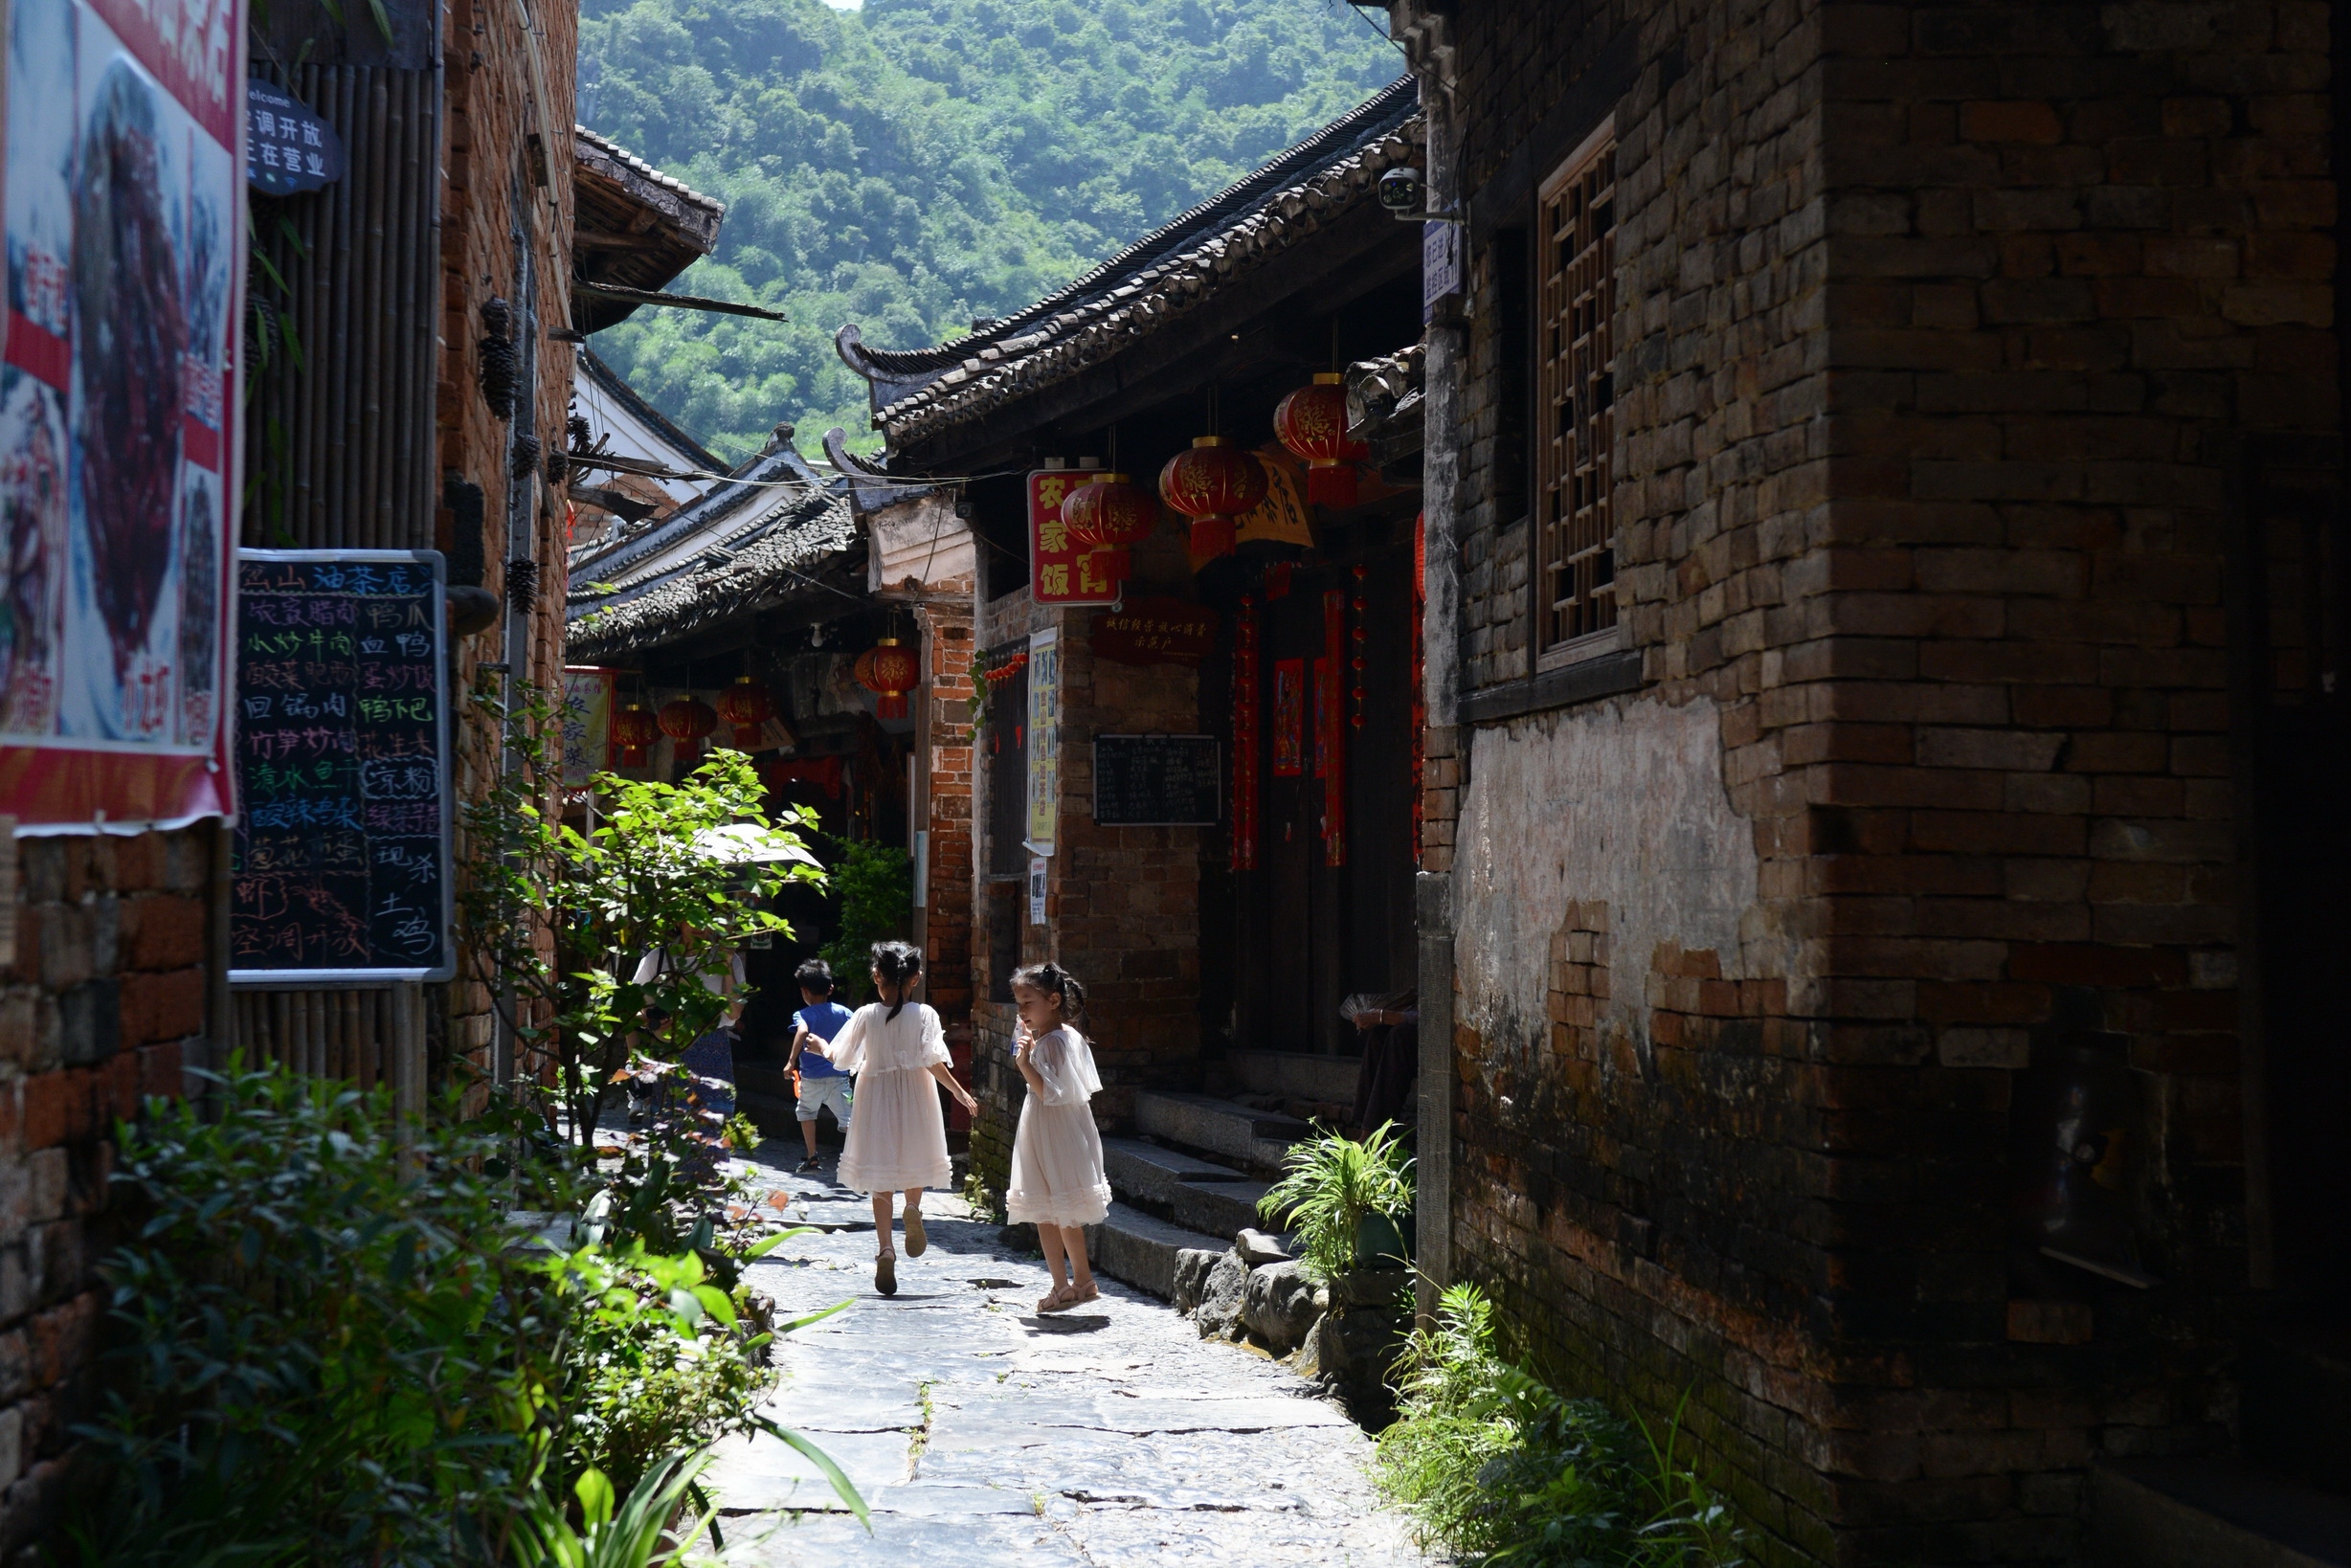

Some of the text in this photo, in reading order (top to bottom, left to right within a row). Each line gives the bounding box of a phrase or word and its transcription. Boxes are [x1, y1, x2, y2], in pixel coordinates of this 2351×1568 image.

[248, 89, 291, 108] elcome
[1039, 477, 1070, 595] 农家饭
[247, 628, 351, 663] 小炒牛肉
[243, 692, 347, 720] 回锅肉
[358, 694, 436, 724] 鸭下巴
[366, 766, 433, 795] 凉粉
